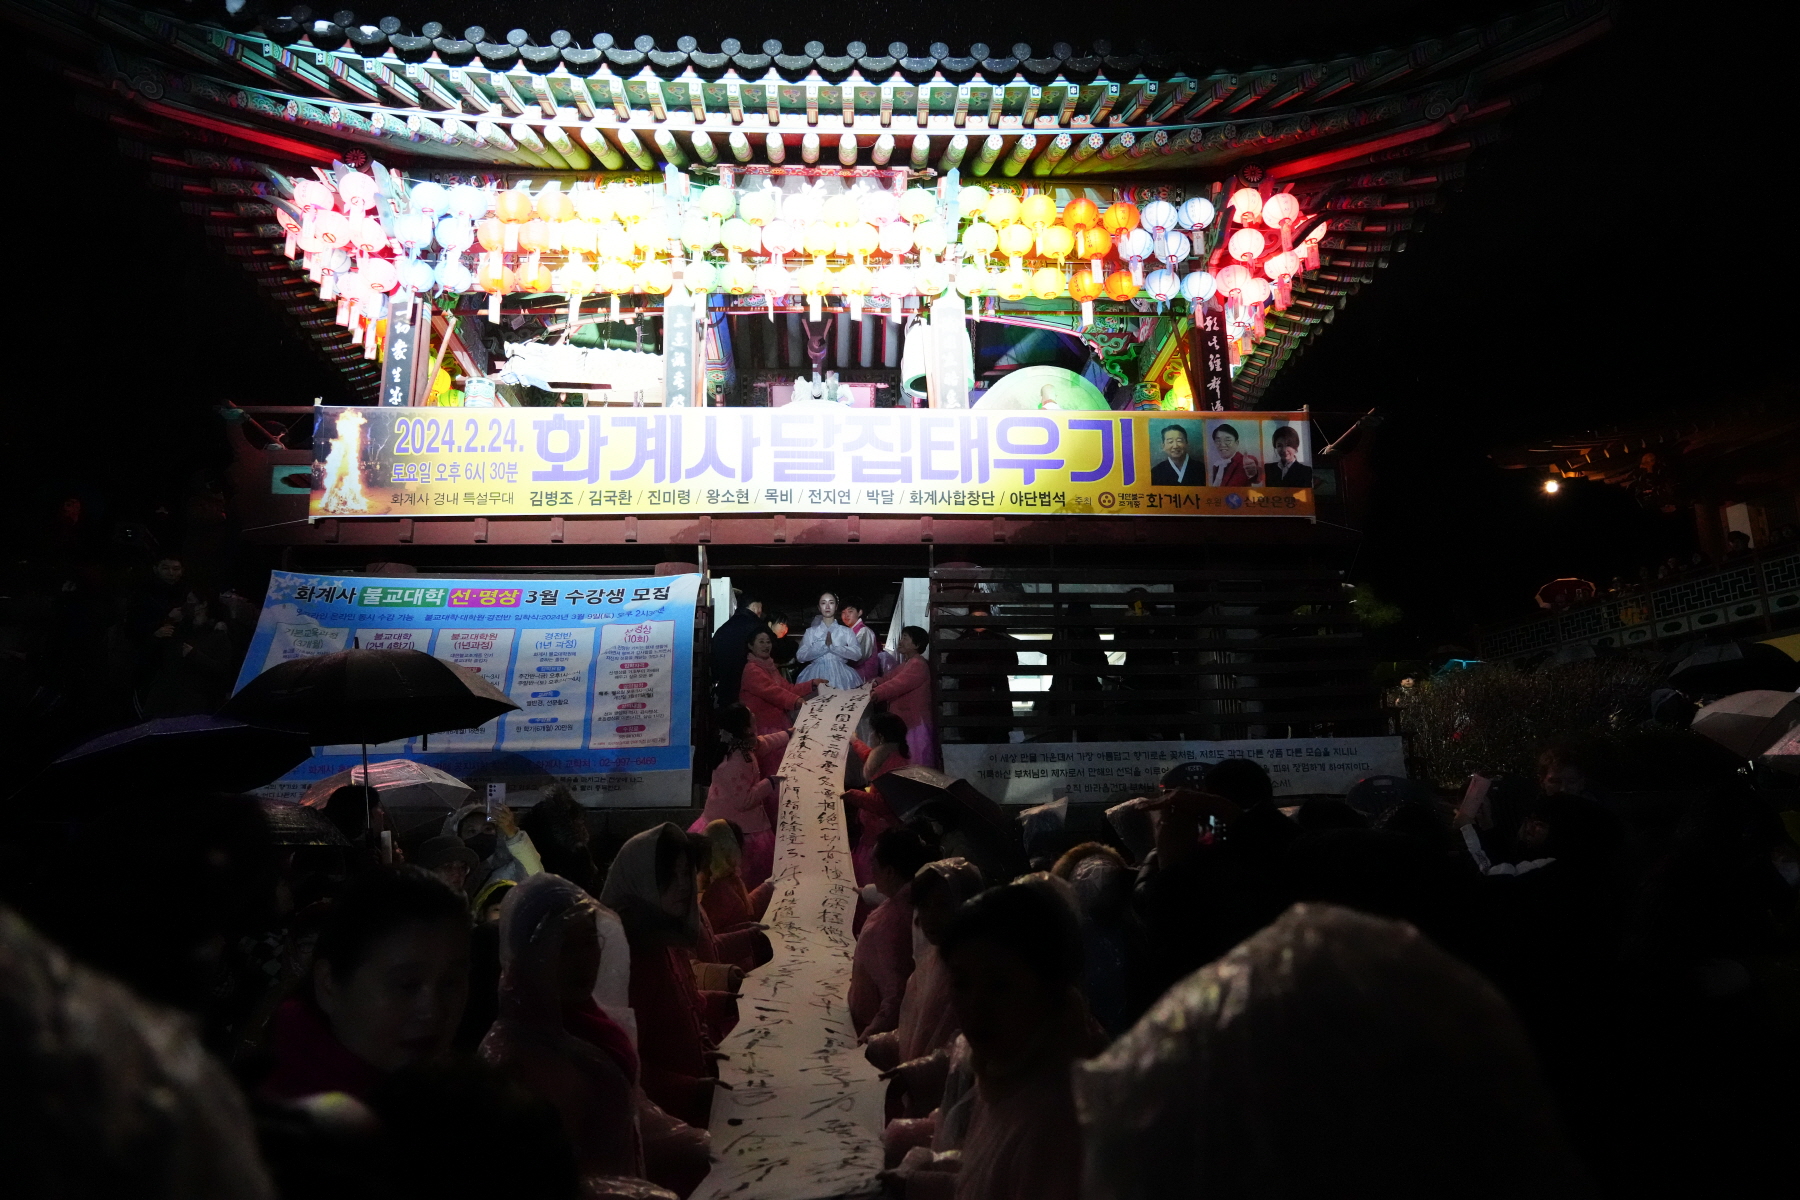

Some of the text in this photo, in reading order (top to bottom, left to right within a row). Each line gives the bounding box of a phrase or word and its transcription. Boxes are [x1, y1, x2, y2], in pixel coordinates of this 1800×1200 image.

[394, 418, 525, 455] 2024.2.24.
[391, 461, 519, 483] 토요일 오후 6시 30분
[391, 490, 514, 506] 화계사 경내 특설무대
[530, 490, 573, 506] 김병조
[588, 490, 632, 506] 김국환
[647, 490, 691, 506] 진미령
[706, 490, 750, 506] 왕소현
[764, 489, 793, 506] 목비
[808, 489, 851, 506] 전지연
[866, 489, 895, 505] 박달
[909, 490, 995, 507] 화계사합창단
[1009, 491, 1067, 508] 야단법석
[1146, 493, 1201, 510] 화계사
[294, 585, 357, 605] 화계사
[363, 586, 446, 606] 불교대학
[525, 590, 559, 606] 3월
[564, 588, 626, 605] 수강생
[630, 586, 671, 602] 모집
[373, 632, 412, 641] 불교대학
[451, 632, 498, 641] 불교대학원
[544, 632, 573, 640] 경전반
[989, 747, 1358, 763] 이 세상 만물 가운데서 가장 아름답고 향기로운 꽃처럼, 저희도 각각 다른 성품 다른 모습을 지니나
[977, 769, 1011, 780] 거룩하신
[1014, 768, 1049, 779] 부처님의
[1051, 767, 1085, 779] 제자로서
[1273, 763, 1290, 773] 피워
[1292, 762, 1326, 773] 장엄하게
[1328, 762, 1373, 772] 하여지이다.
[1064, 783, 1082, 794] 오직
[1130, 782, 1155, 792] 부처님
